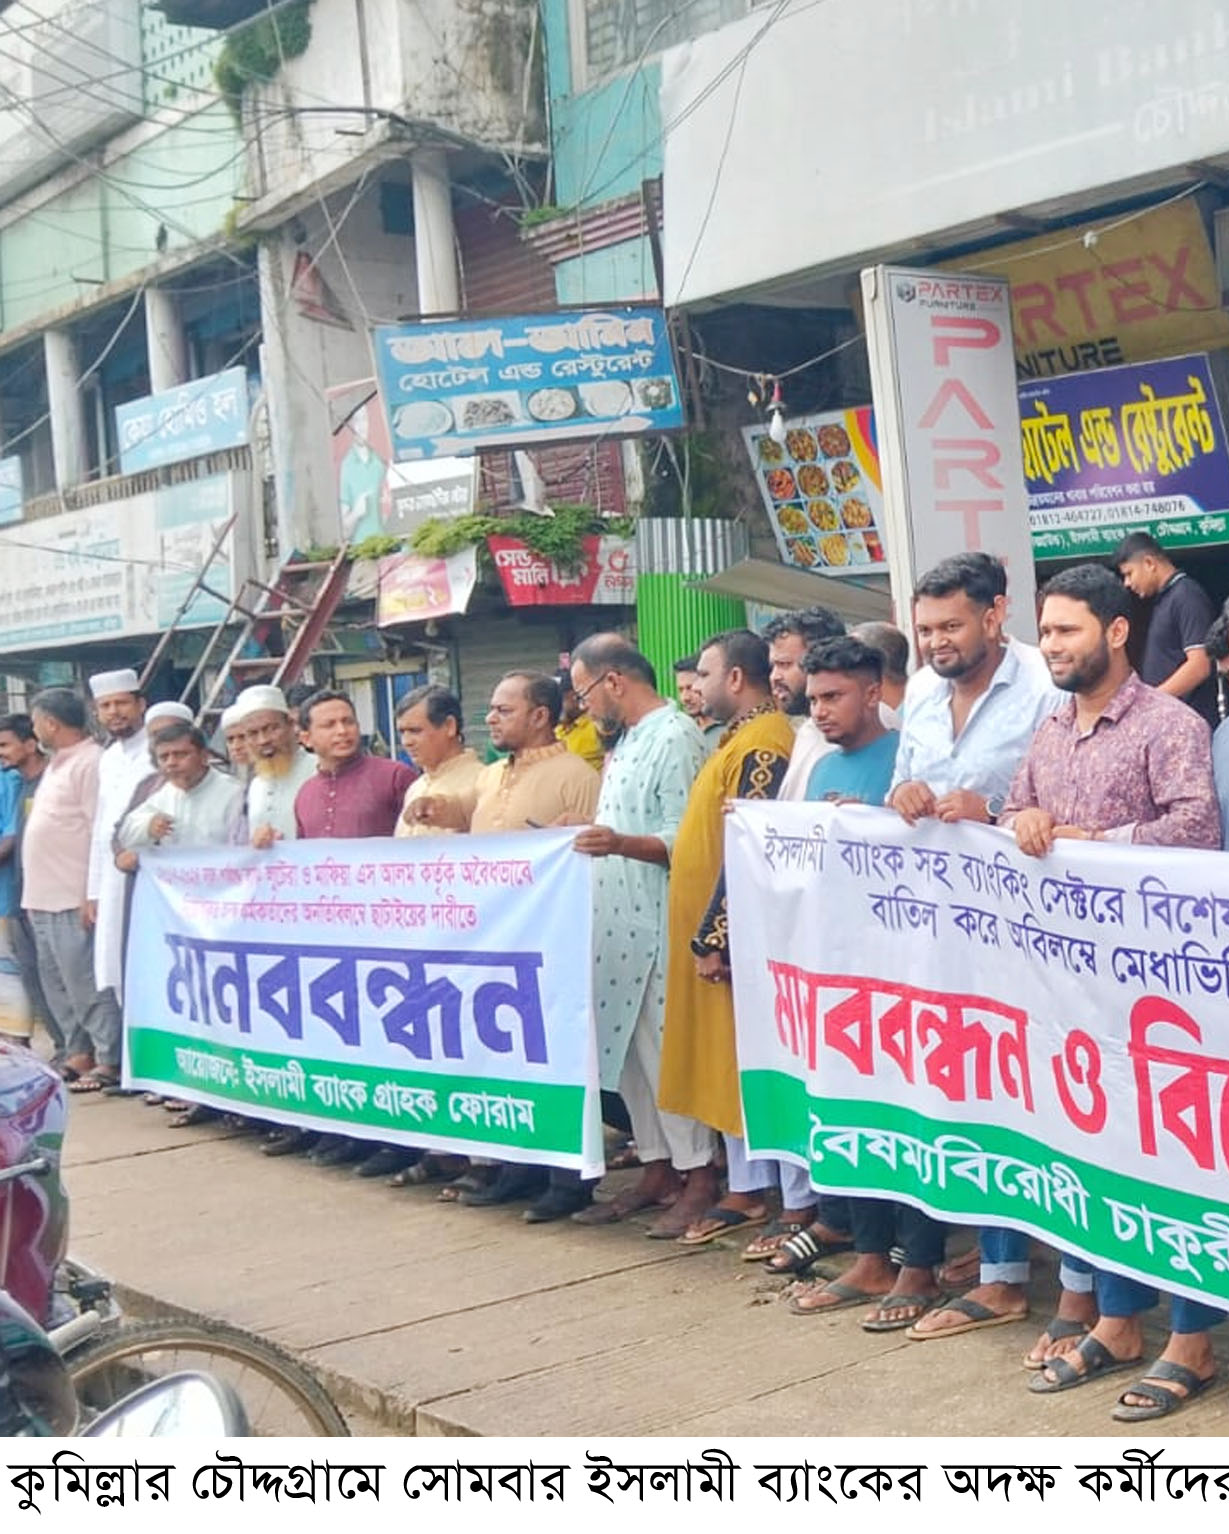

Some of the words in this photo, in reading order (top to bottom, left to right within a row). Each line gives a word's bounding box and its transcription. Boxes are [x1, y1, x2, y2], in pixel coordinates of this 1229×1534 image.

[917, 280, 1003, 302] PARTEX
[1011, 247, 1209, 347] RTEX
[399, 365, 490, 392] হোটেল
[1015, 337, 1124, 378] NITURE
[917, 315, 1010, 618] PART
[430, 894, 478, 929] দাবীতে
[764, 824, 828, 875] ইসলামী
[838, 838, 904, 881] ব্যাংক
[912, 846, 954, 889] সহ
[959, 853, 1035, 912] ব্যাংকিং
[1039, 866, 1126, 927] সেক্টরে
[868, 884, 939, 939] বাতিল
[950, 903, 1001, 951] করে
[1005, 912, 1098, 976] অবিলম্বে
[164, 932, 549, 1065] মানববন্ধন
[240, 1053, 307, 1102] ইসলামী
[310, 1073, 369, 1110] ব্যাংক
[372, 1080, 439, 1122] গ্রাহক
[448, 1090, 535, 1133] ফোরাম
[1051, 1029, 1109, 1135] ও
[808, 1106, 1091, 1231] বৈষম্যবিরোধী
